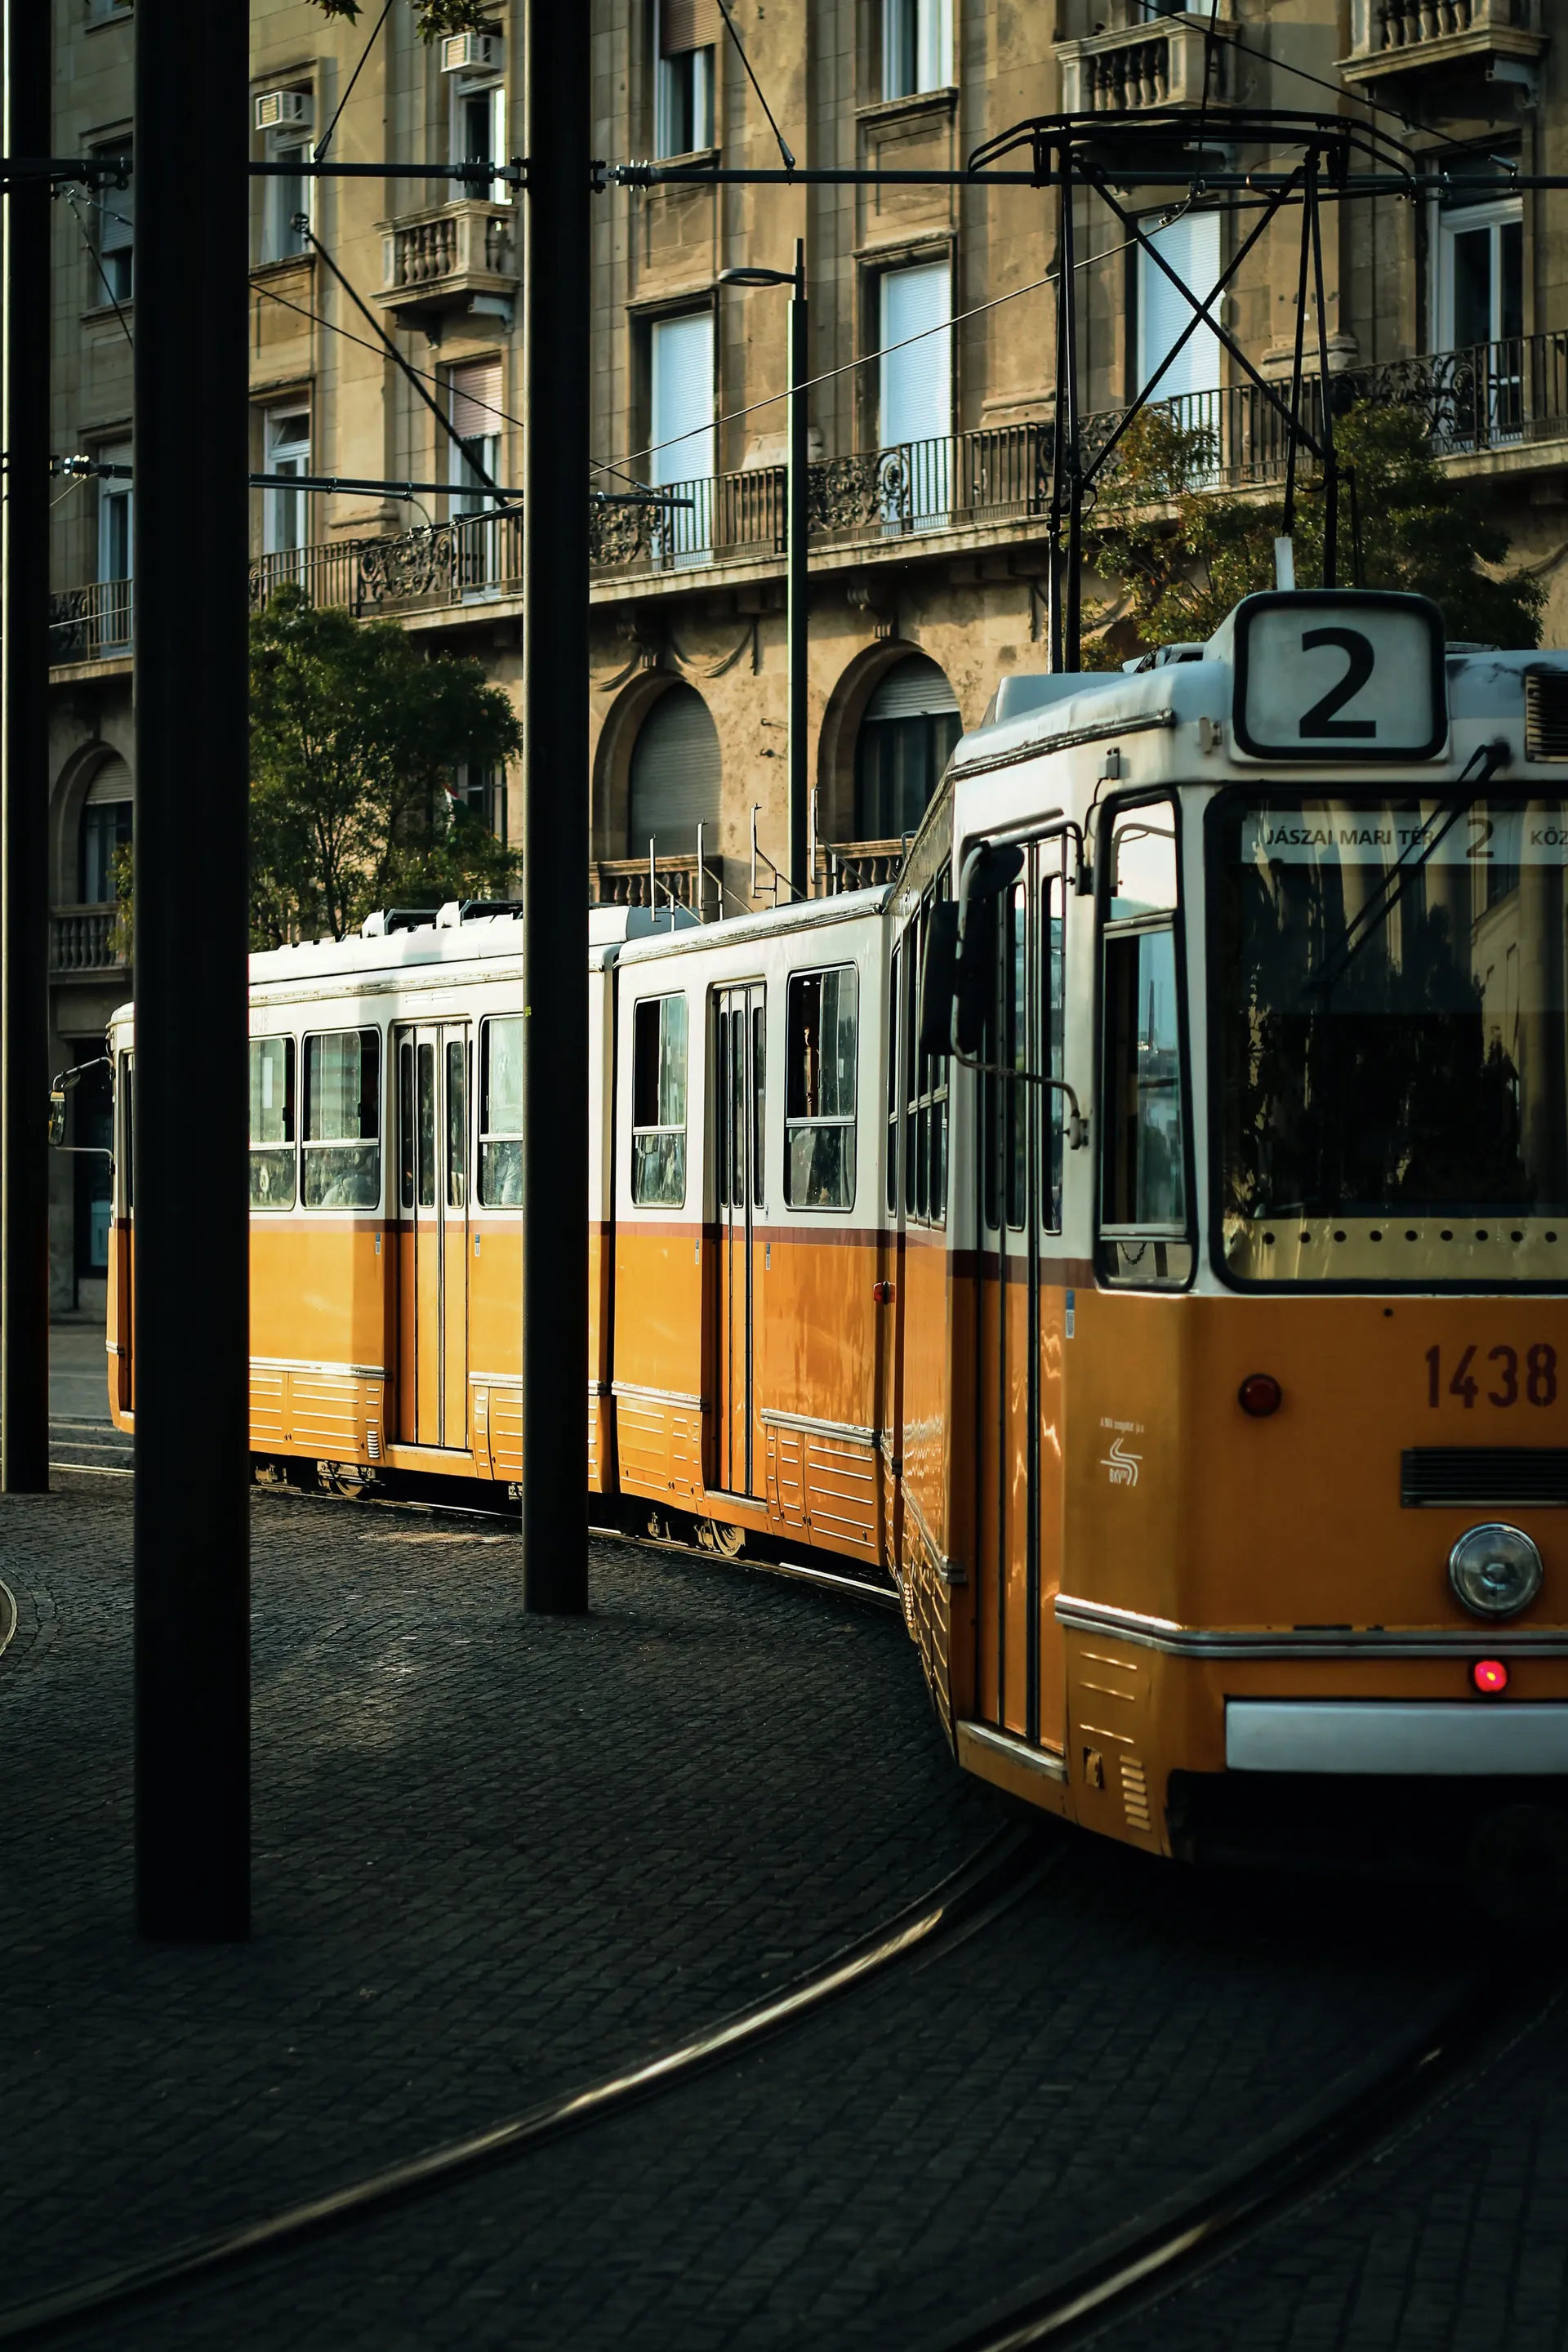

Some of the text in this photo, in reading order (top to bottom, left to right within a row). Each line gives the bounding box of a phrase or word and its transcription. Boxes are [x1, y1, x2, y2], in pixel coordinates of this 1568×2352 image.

[1298, 626, 1377, 738] 2
[1267, 826, 1332, 845] JÁSZAI
[1340, 829, 1392, 845] MARI
[1397, 826, 1434, 845] TÉR
[1466, 817, 1494, 858] 2
[1425, 1343, 1557, 1409] 1438
